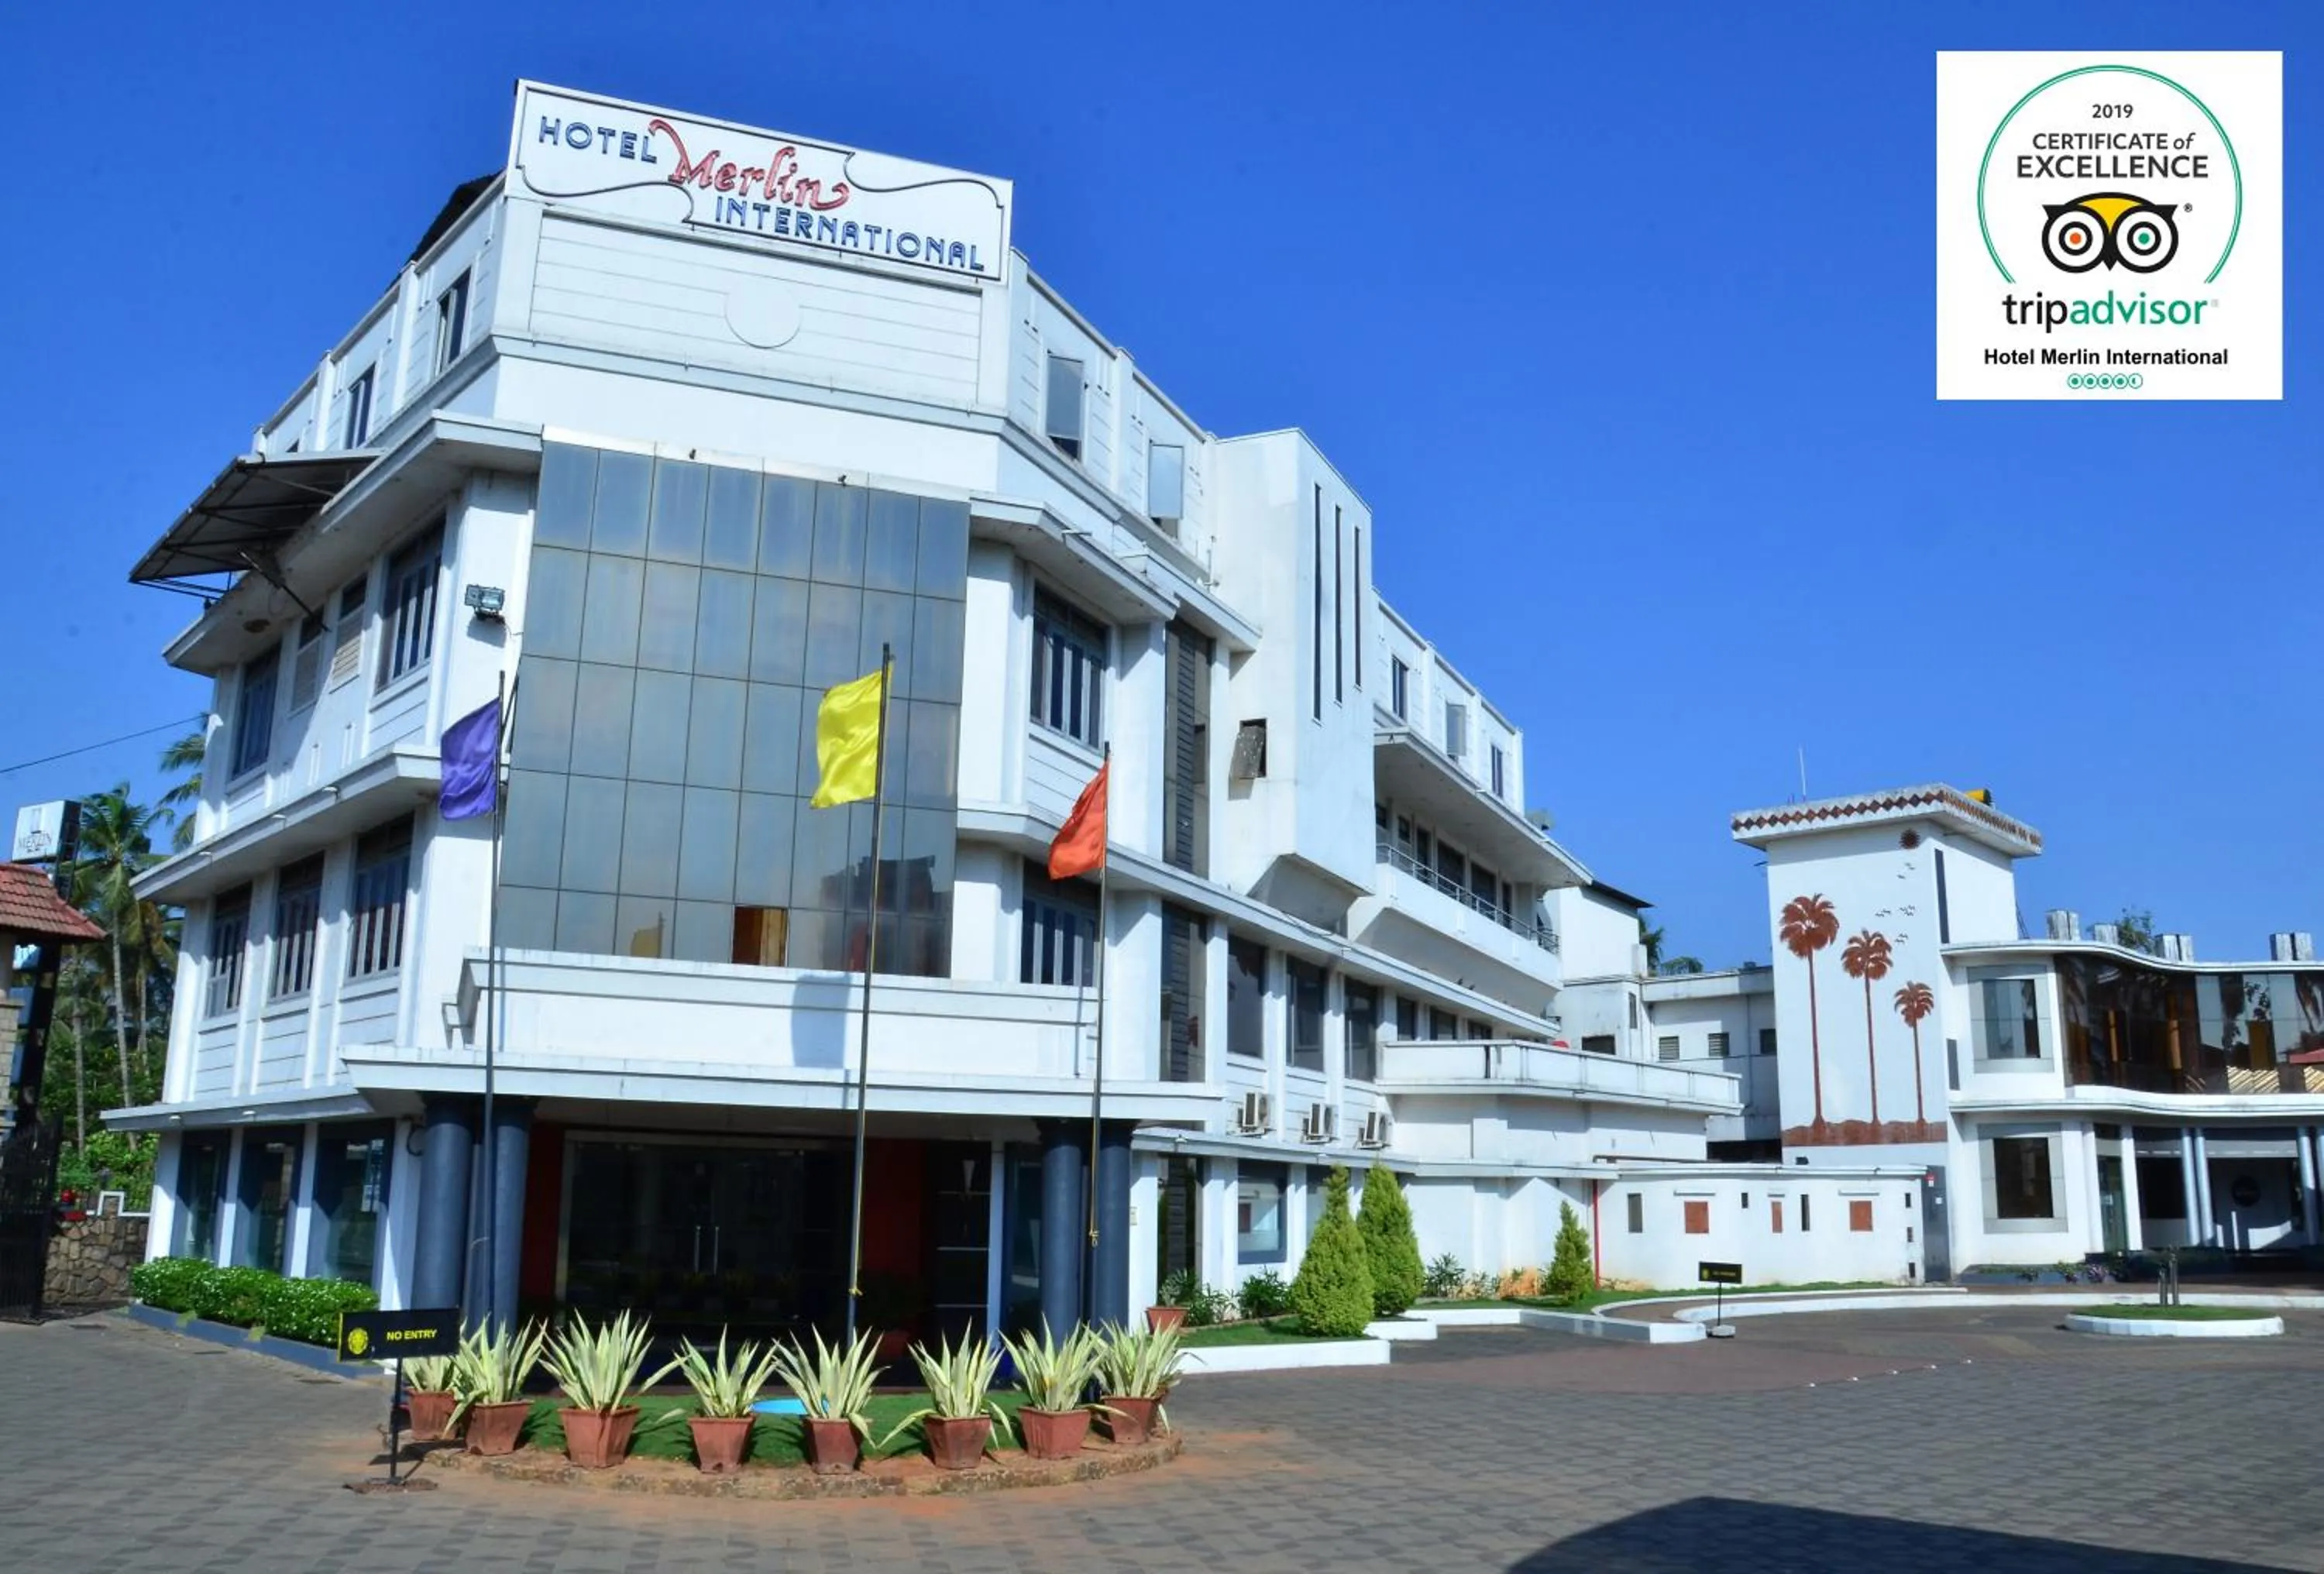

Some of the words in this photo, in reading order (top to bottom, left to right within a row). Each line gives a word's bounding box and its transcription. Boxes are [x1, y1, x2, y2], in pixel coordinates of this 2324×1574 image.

[539, 115, 657, 163] HOTEL
[648, 119, 849, 211] Merlin
[714, 196, 985, 272] INTERNATIONAL
[387, 1332, 402, 1340] NO
[404, 1329, 438, 1339] ENTRY
